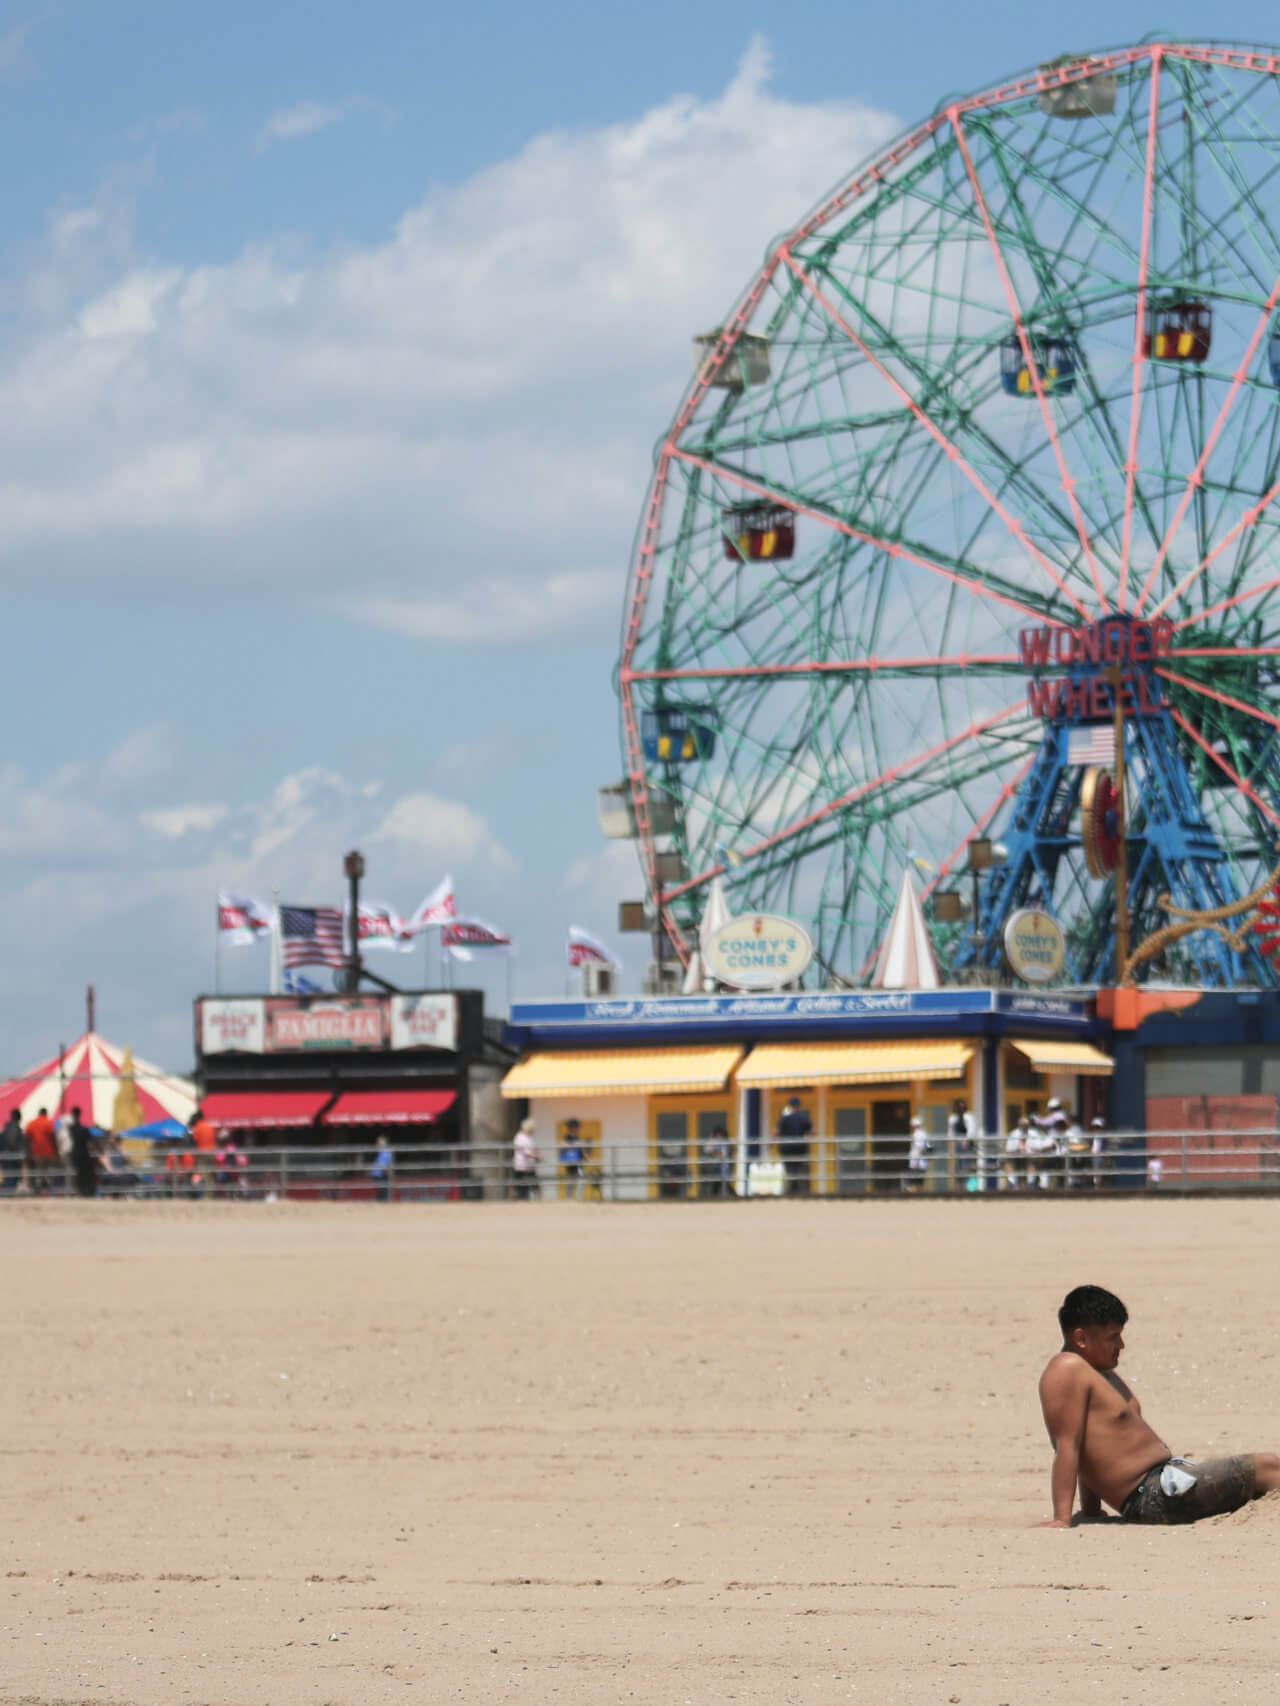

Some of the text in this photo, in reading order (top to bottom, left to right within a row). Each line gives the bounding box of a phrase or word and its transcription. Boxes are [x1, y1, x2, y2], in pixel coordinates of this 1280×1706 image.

[1020, 617, 1174, 668] WONDER
[1028, 673, 1169, 719] WHEEL
[718, 938, 796, 953] CONEY'S
[1014, 933, 1057, 950] CONEY'S
[727, 953, 788, 968] CONES
[1019, 950, 1053, 963] CONES
[277, 1013, 378, 1039] FAMIGLIA
